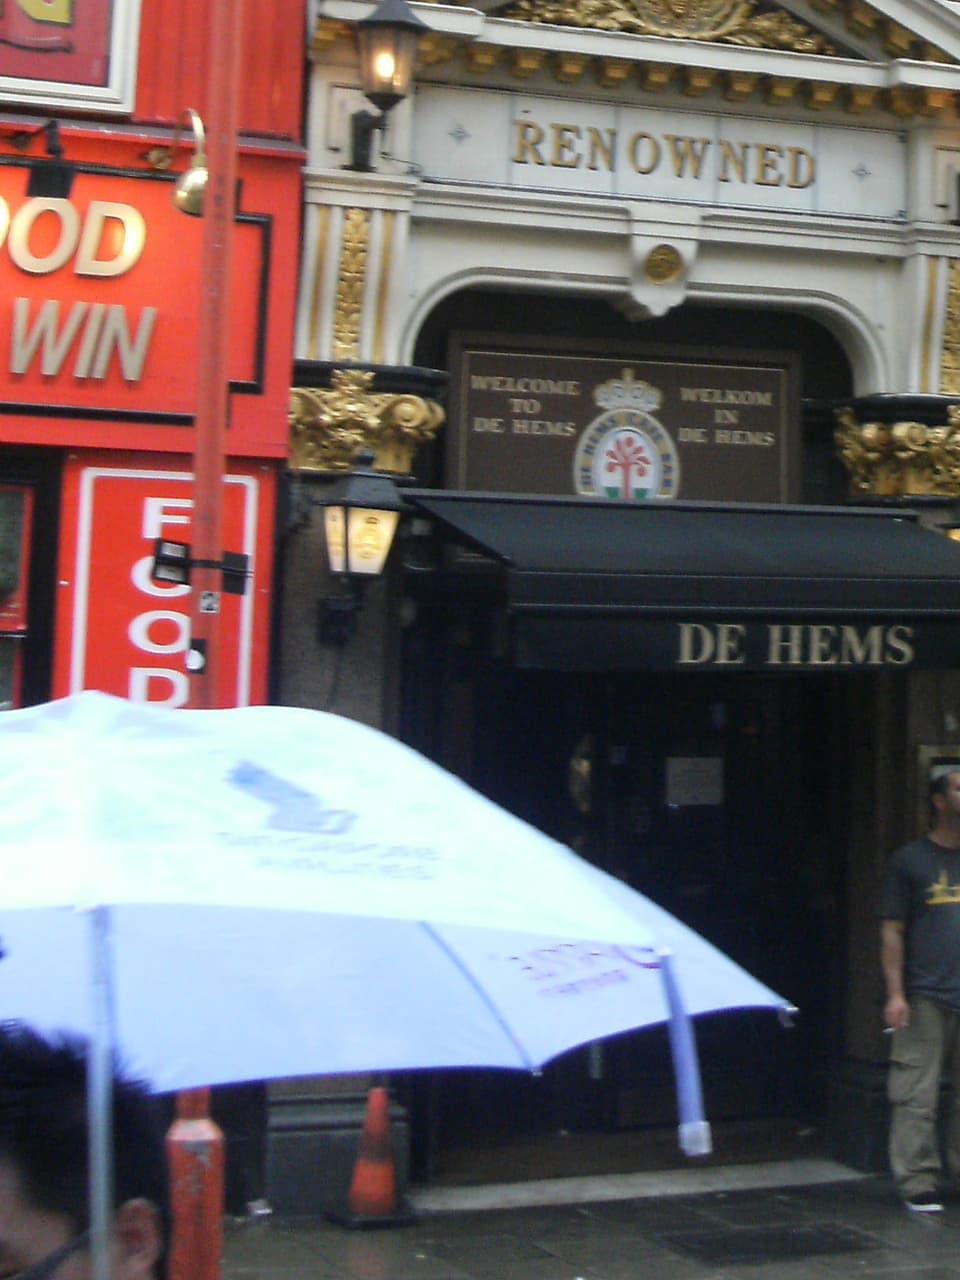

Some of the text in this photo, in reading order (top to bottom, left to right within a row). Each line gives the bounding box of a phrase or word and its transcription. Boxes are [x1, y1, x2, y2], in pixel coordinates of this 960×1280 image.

[512, 118, 816, 189] RENOWNED
[0, 195, 147, 277] OD
[471, 375, 581, 396] WELCOME
[508, 398, 542, 414] TO
[680, 387, 773, 407] WELKOM
[473, 416, 577, 437] DE HEMS
[714, 408, 739, 424] IN
[678, 427, 776, 447] DE HEMS
[676, 622, 915, 665] DE HEMS
